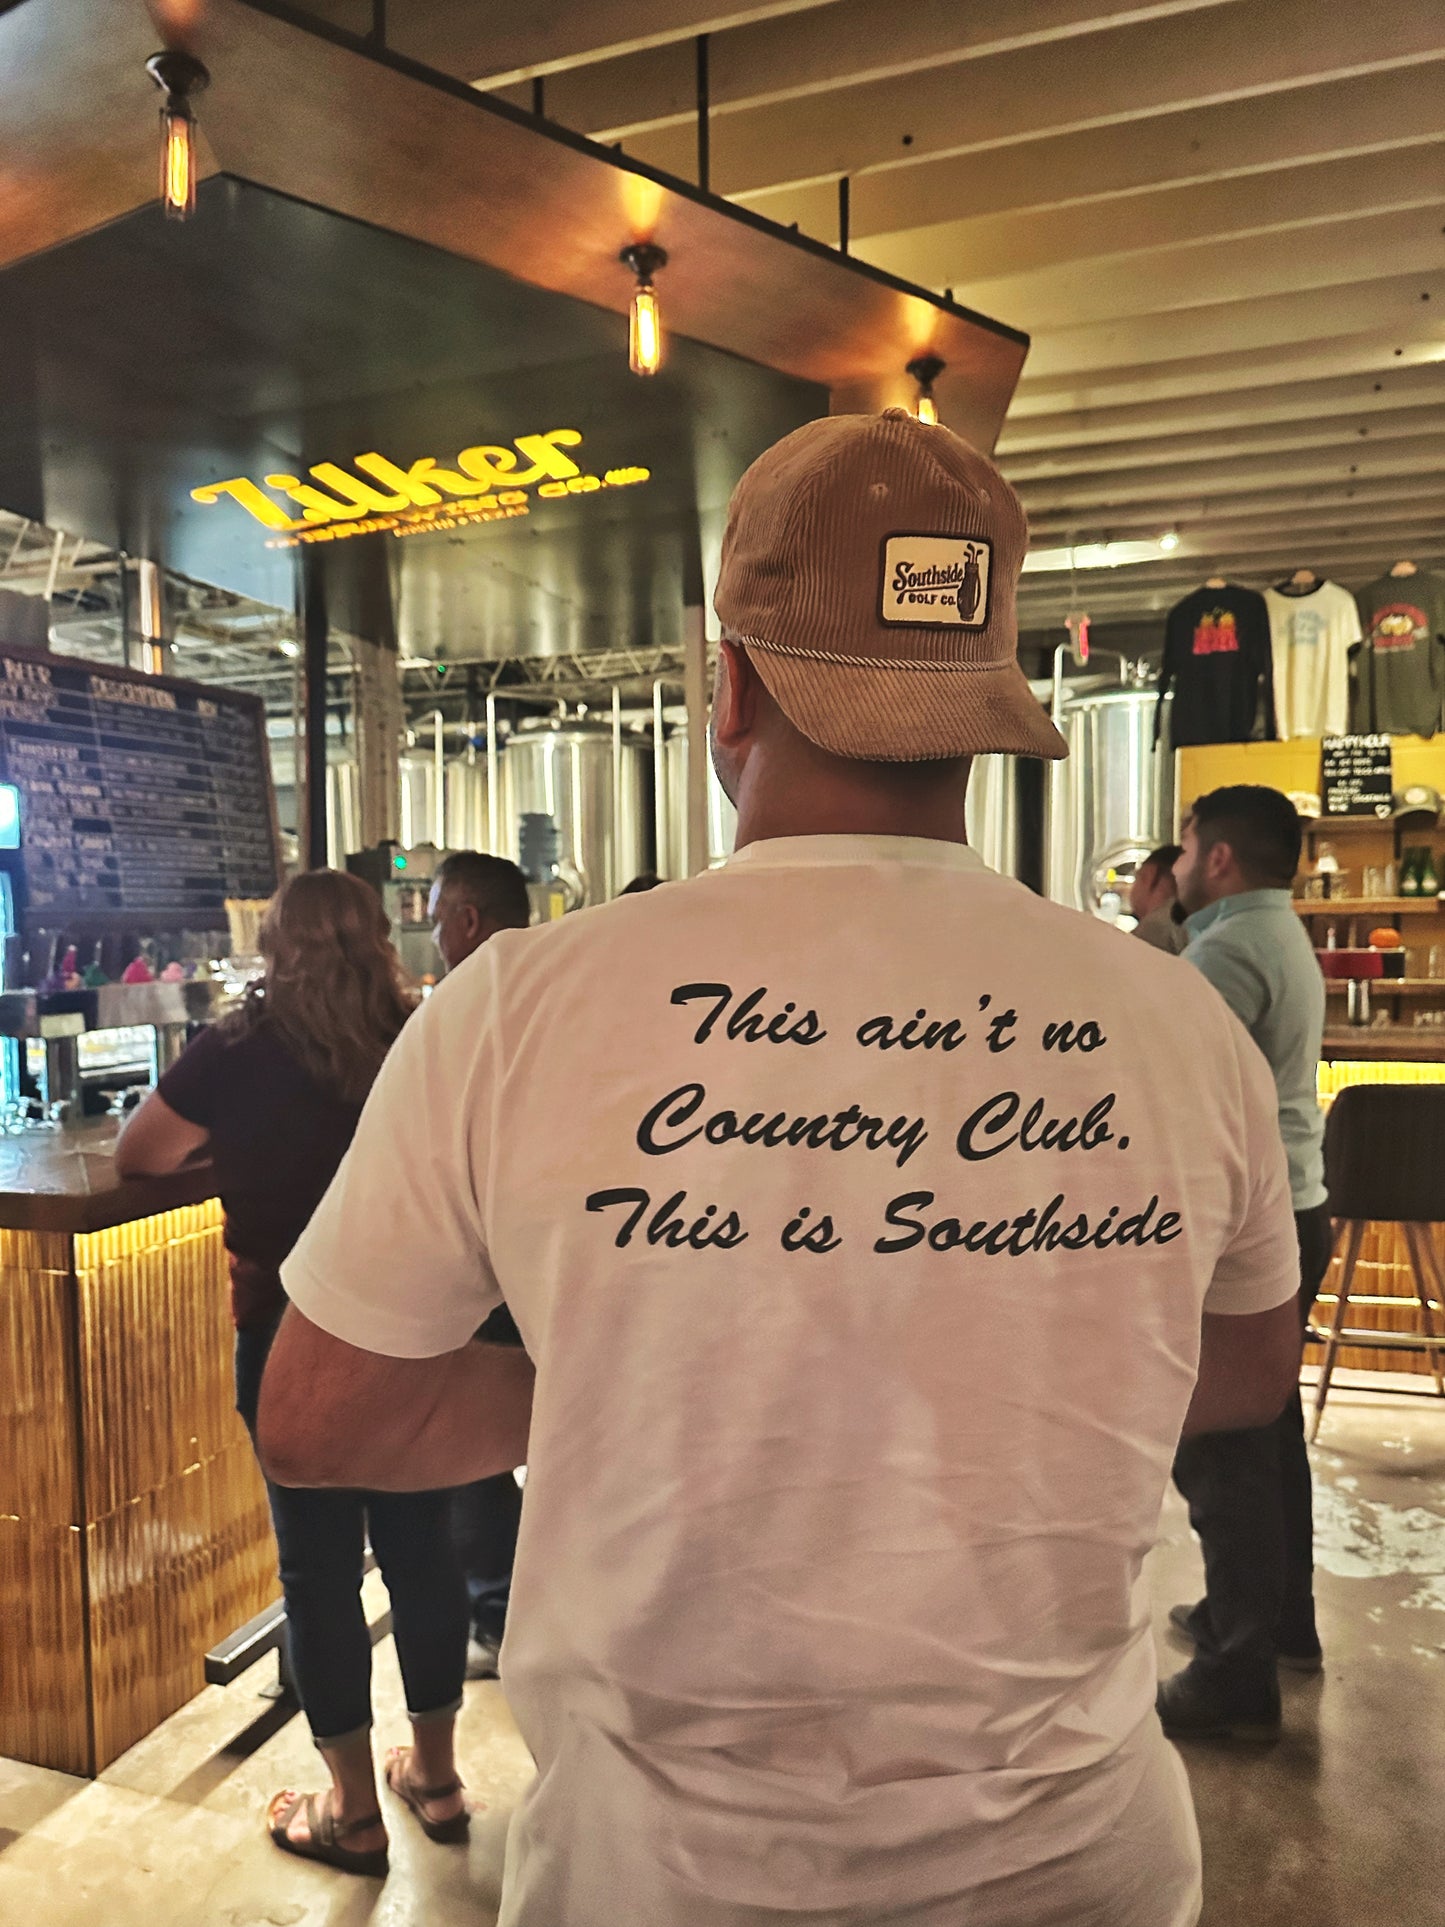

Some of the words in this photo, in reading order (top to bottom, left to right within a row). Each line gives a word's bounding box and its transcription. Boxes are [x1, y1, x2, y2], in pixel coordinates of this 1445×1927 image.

[190, 428, 582, 531] Zilker
[892, 561, 964, 591] Southside
[908, 593, 938, 605] GOLF
[670, 982, 828, 1046] This
[856, 994, 1018, 1053] ain't
[1042, 1019, 1107, 1053] no
[636, 1083, 928, 1168] Country
[956, 1091, 1130, 1162] Club.
[585, 1187, 749, 1250] This
[780, 1206, 843, 1254] is
[873, 1190, 1183, 1257] Southside
